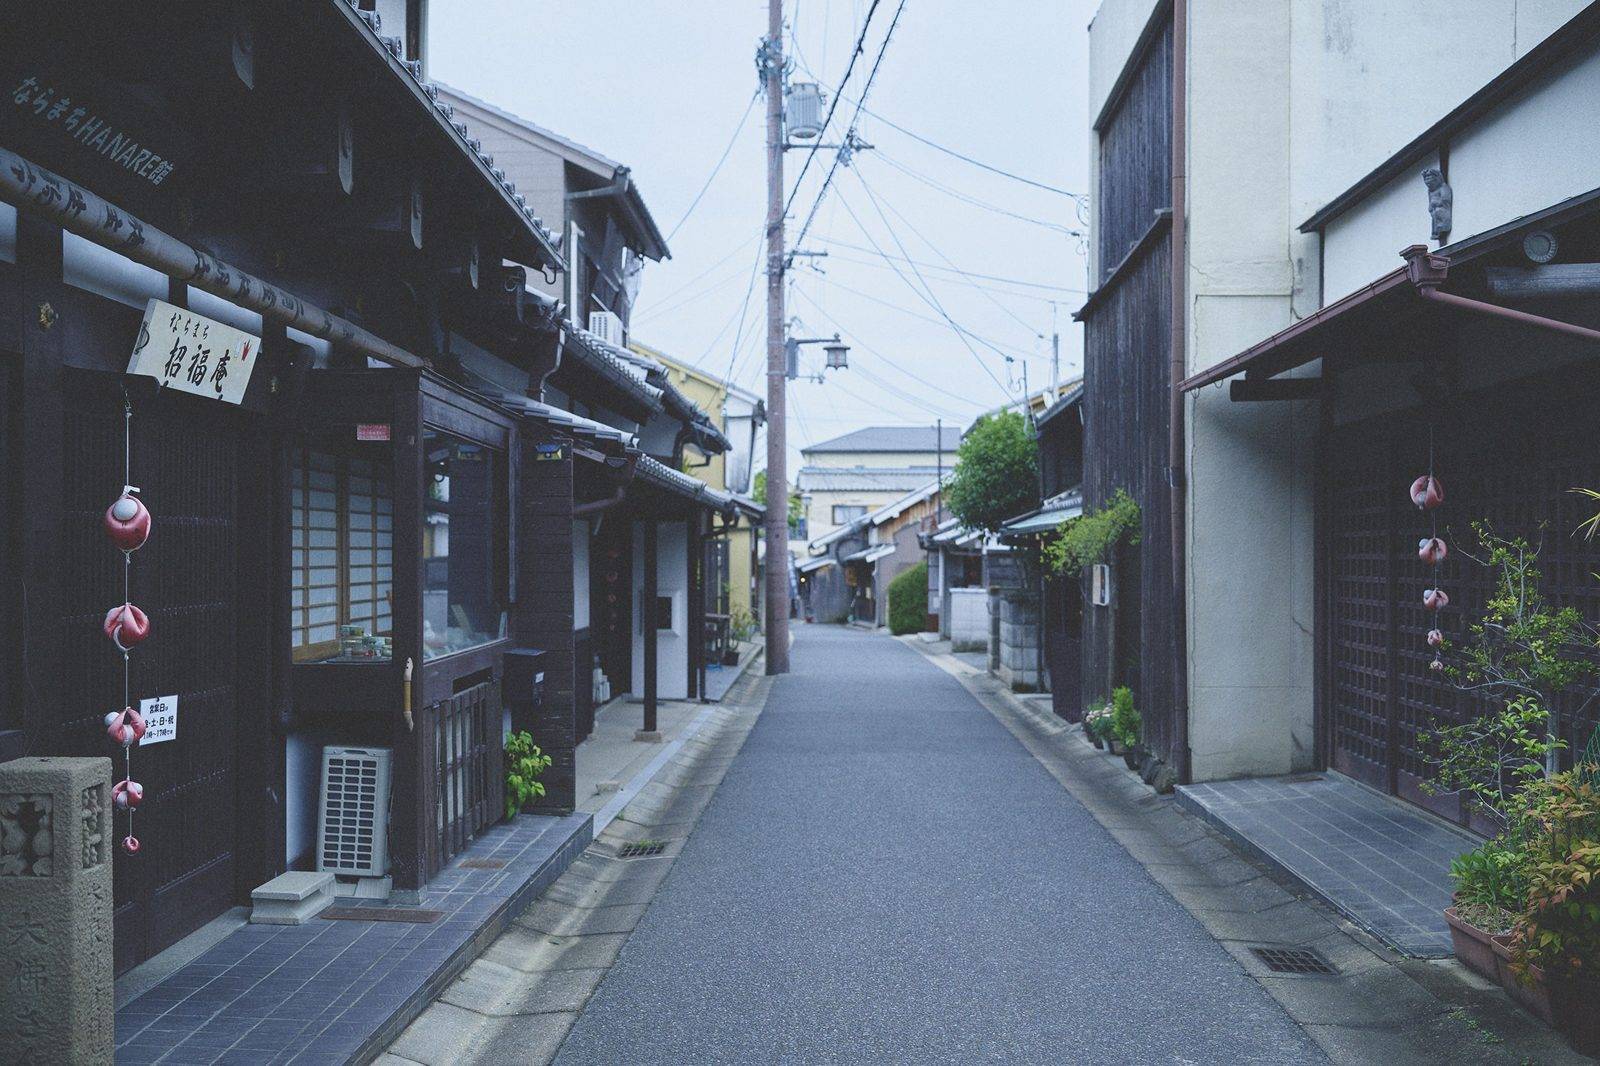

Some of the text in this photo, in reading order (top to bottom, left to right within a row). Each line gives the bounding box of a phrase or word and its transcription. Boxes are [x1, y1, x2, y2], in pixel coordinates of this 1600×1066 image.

[169, 312, 209, 341] ならまち
[164, 336, 231, 393] 招福庵
